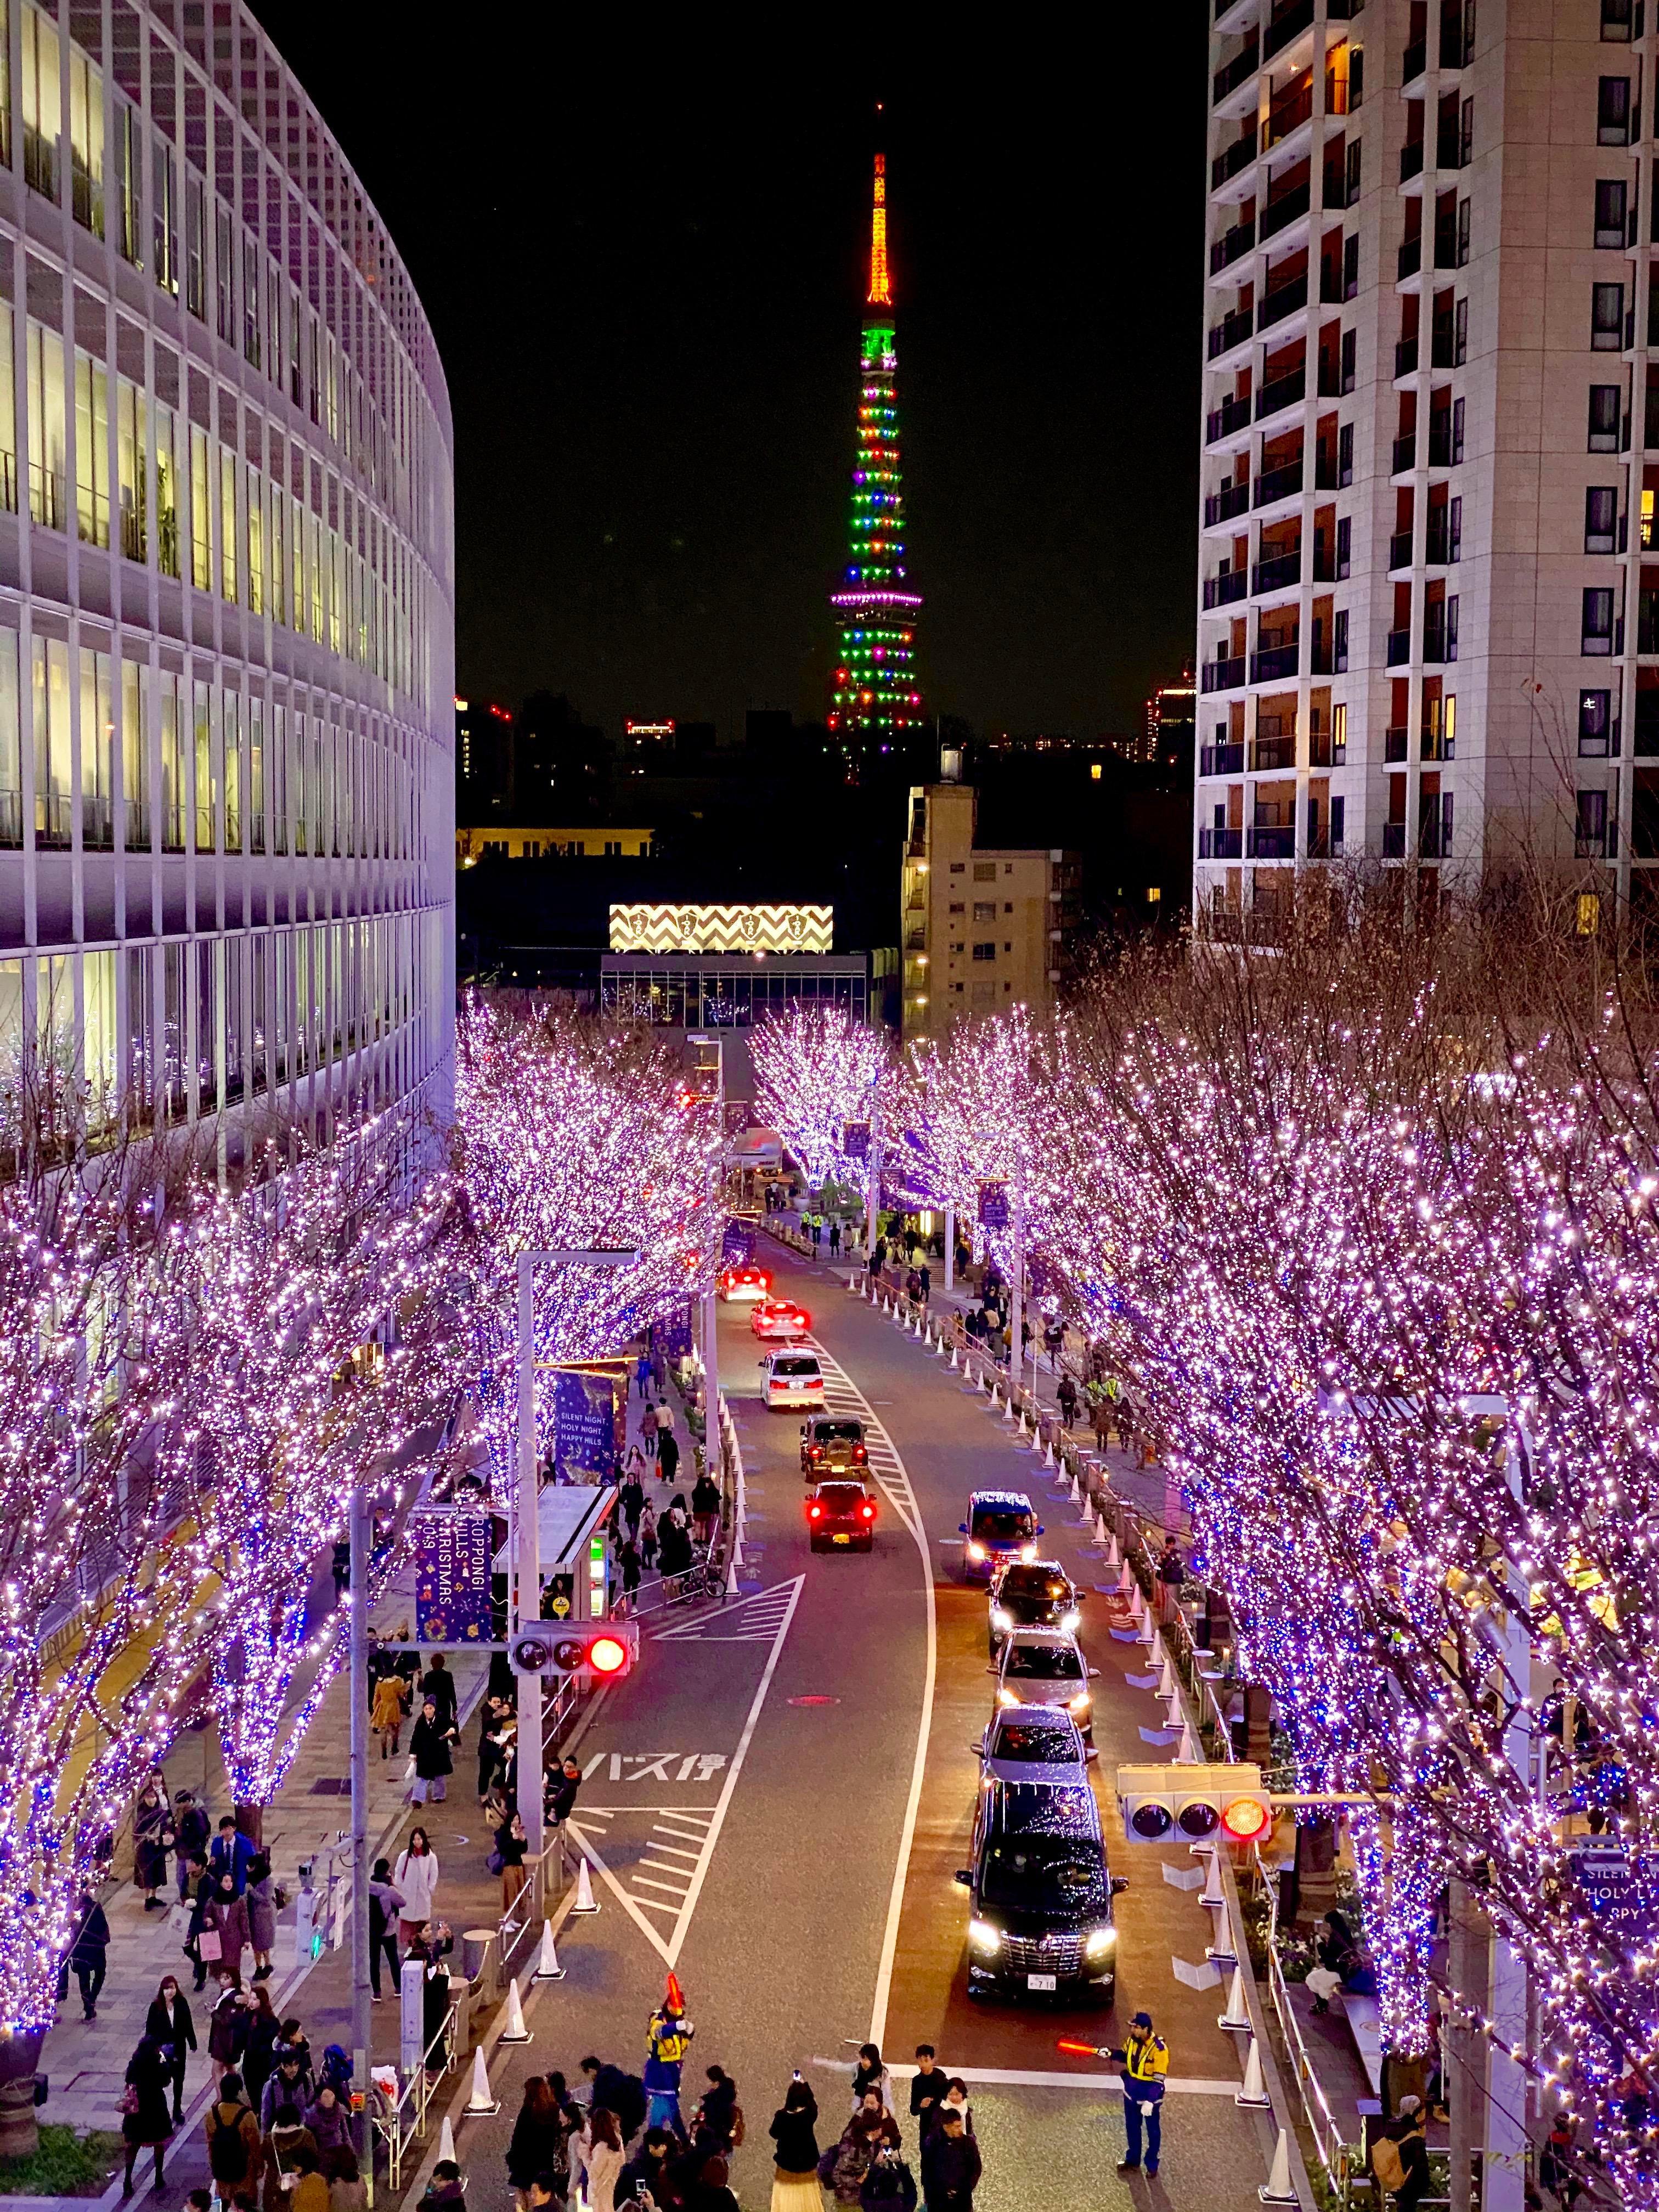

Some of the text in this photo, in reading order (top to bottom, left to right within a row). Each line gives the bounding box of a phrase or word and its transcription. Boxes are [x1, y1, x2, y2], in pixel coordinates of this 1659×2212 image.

[561, 1413, 583, 1421] SILENT
[561, 1423, 579, 1431] HOLY
[561, 1434, 583, 1442] HAPPY
[472, 1519, 484, 1590] ROPPONGI
[582, 1753, 728, 1781] バス停
